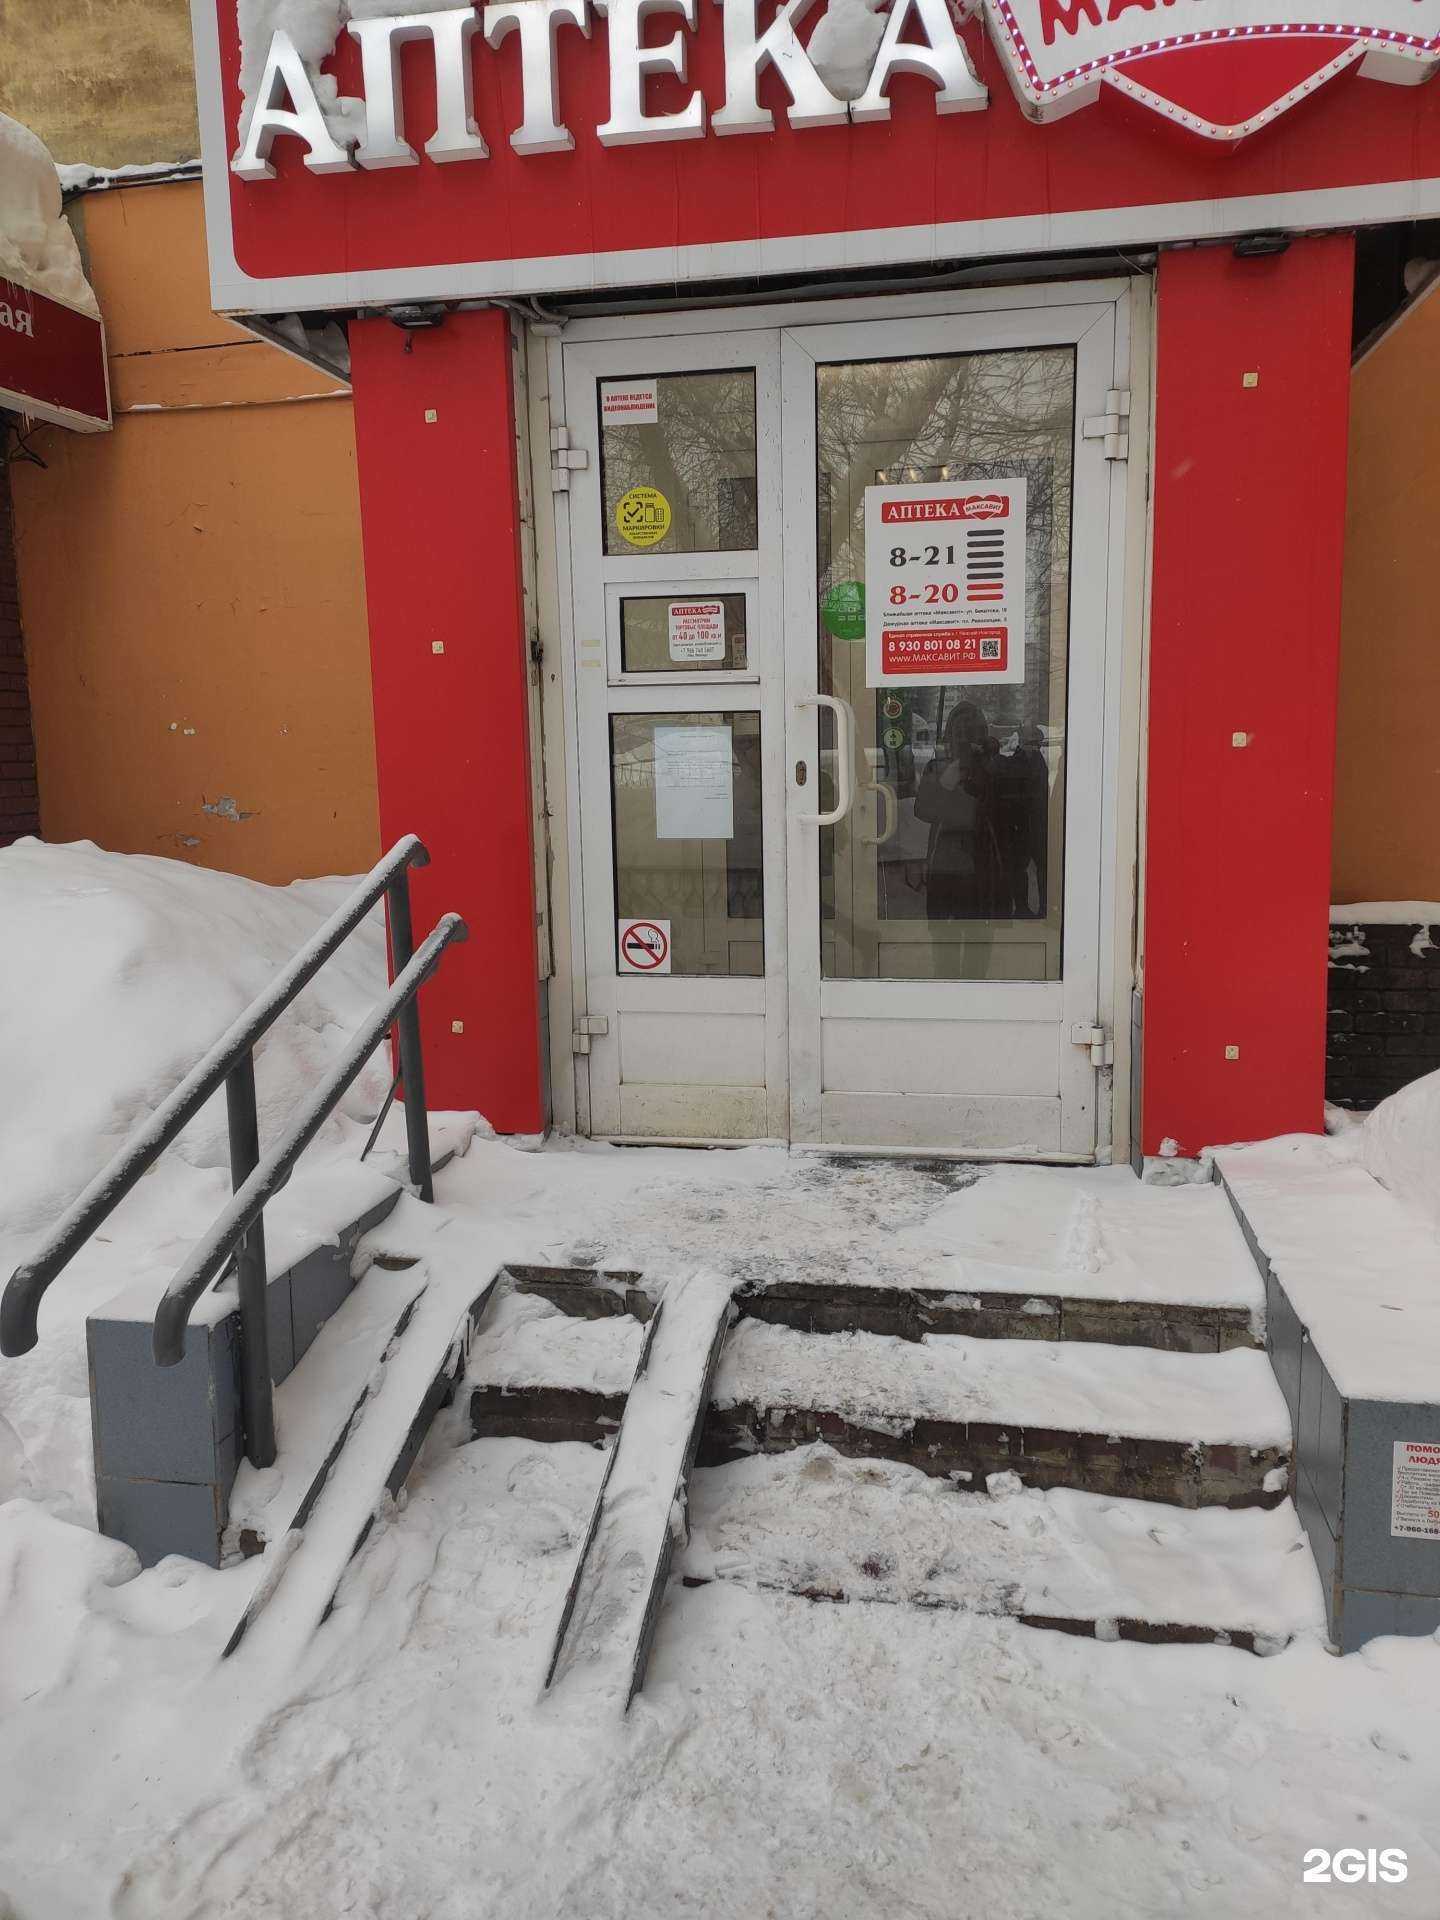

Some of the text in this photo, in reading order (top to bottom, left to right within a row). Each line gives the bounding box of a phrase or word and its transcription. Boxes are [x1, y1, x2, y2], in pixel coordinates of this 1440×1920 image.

[231, 0, 988, 181] АПТЕКА
[0, 302, 34, 338] ая
[888, 503, 961, 520] АПТЕКА
[889, 545, 955, 567] 8-21
[889, 583, 959, 605] 8-20
[888, 641, 896, 652] 8
[900, 640, 921, 651] 930
[946, 639, 960, 650] 08
[964, 638, 977, 649] 21
